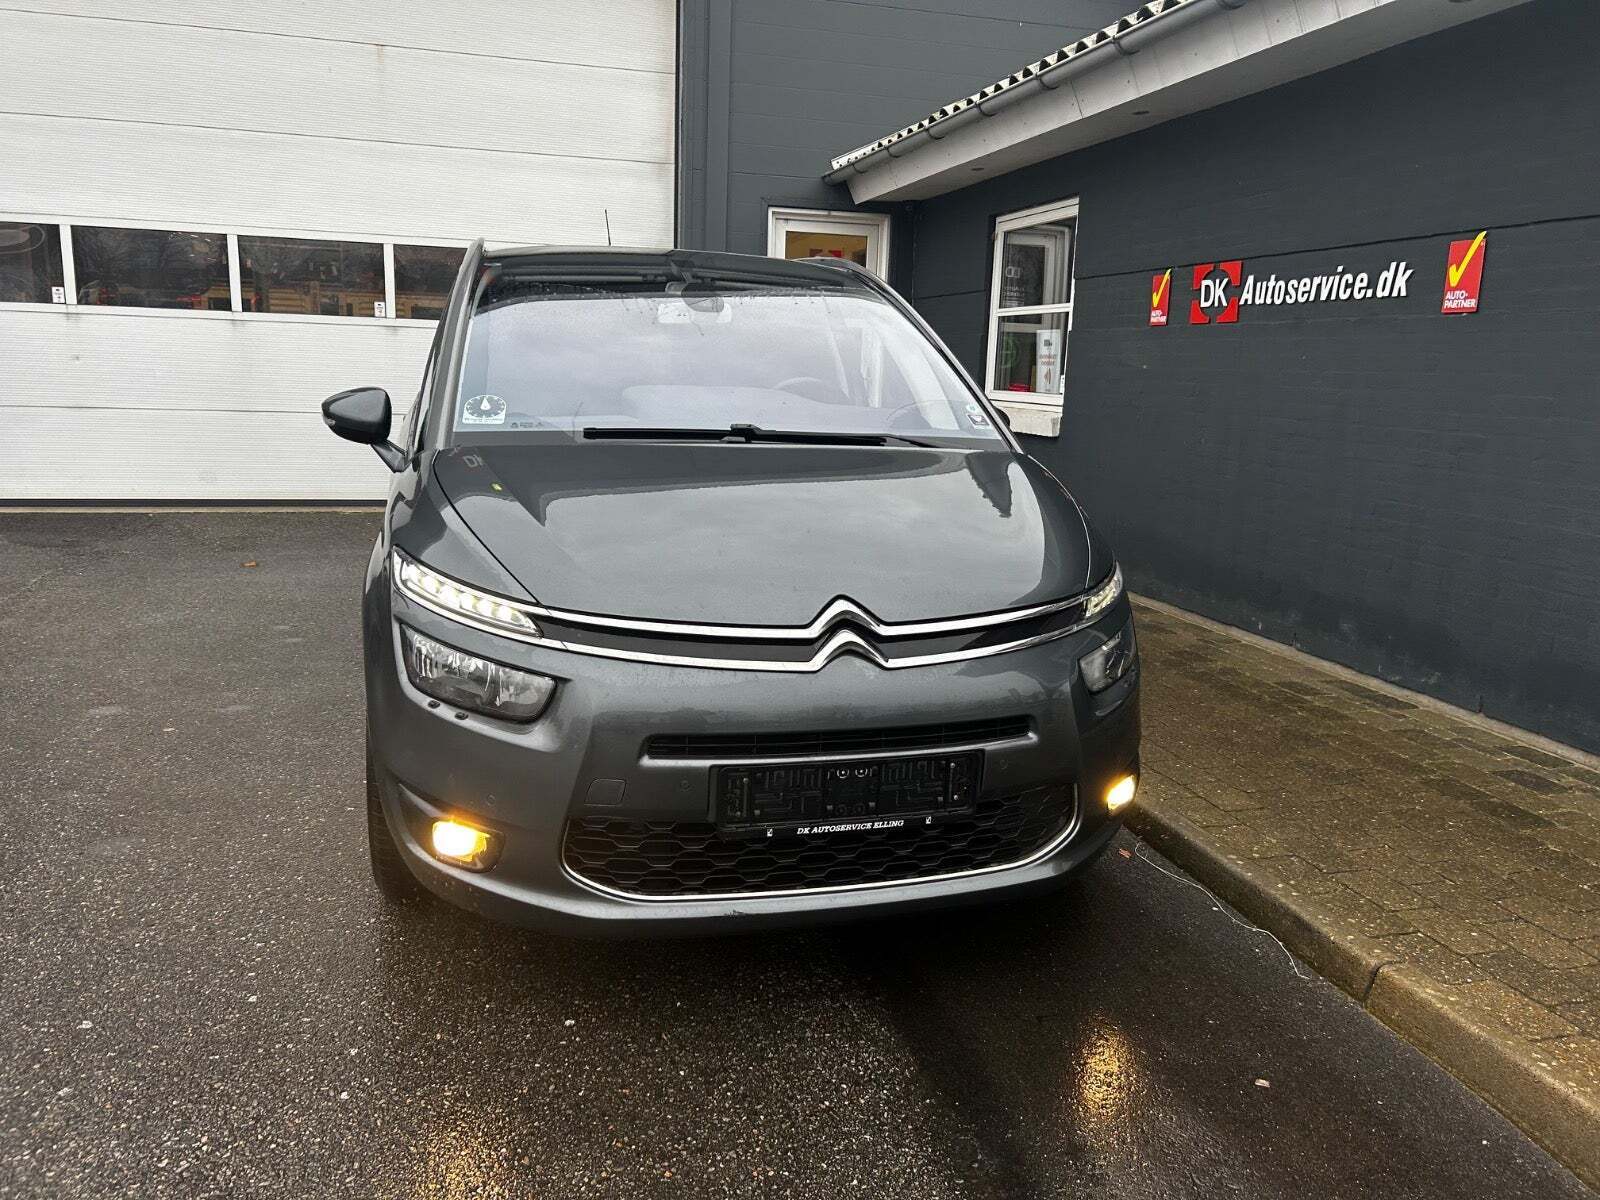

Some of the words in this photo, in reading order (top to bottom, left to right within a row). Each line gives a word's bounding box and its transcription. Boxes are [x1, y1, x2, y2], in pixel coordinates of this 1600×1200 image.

[1200, 279, 1229, 308] DK
[1239, 262, 1414, 305] Autoservice.dk
[1443, 298, 1476, 309] PARTNER
[797, 827, 811, 835] DK
[811, 822, 873, 834] AUTOSERVICE
[873, 819, 904, 829] ELLING
